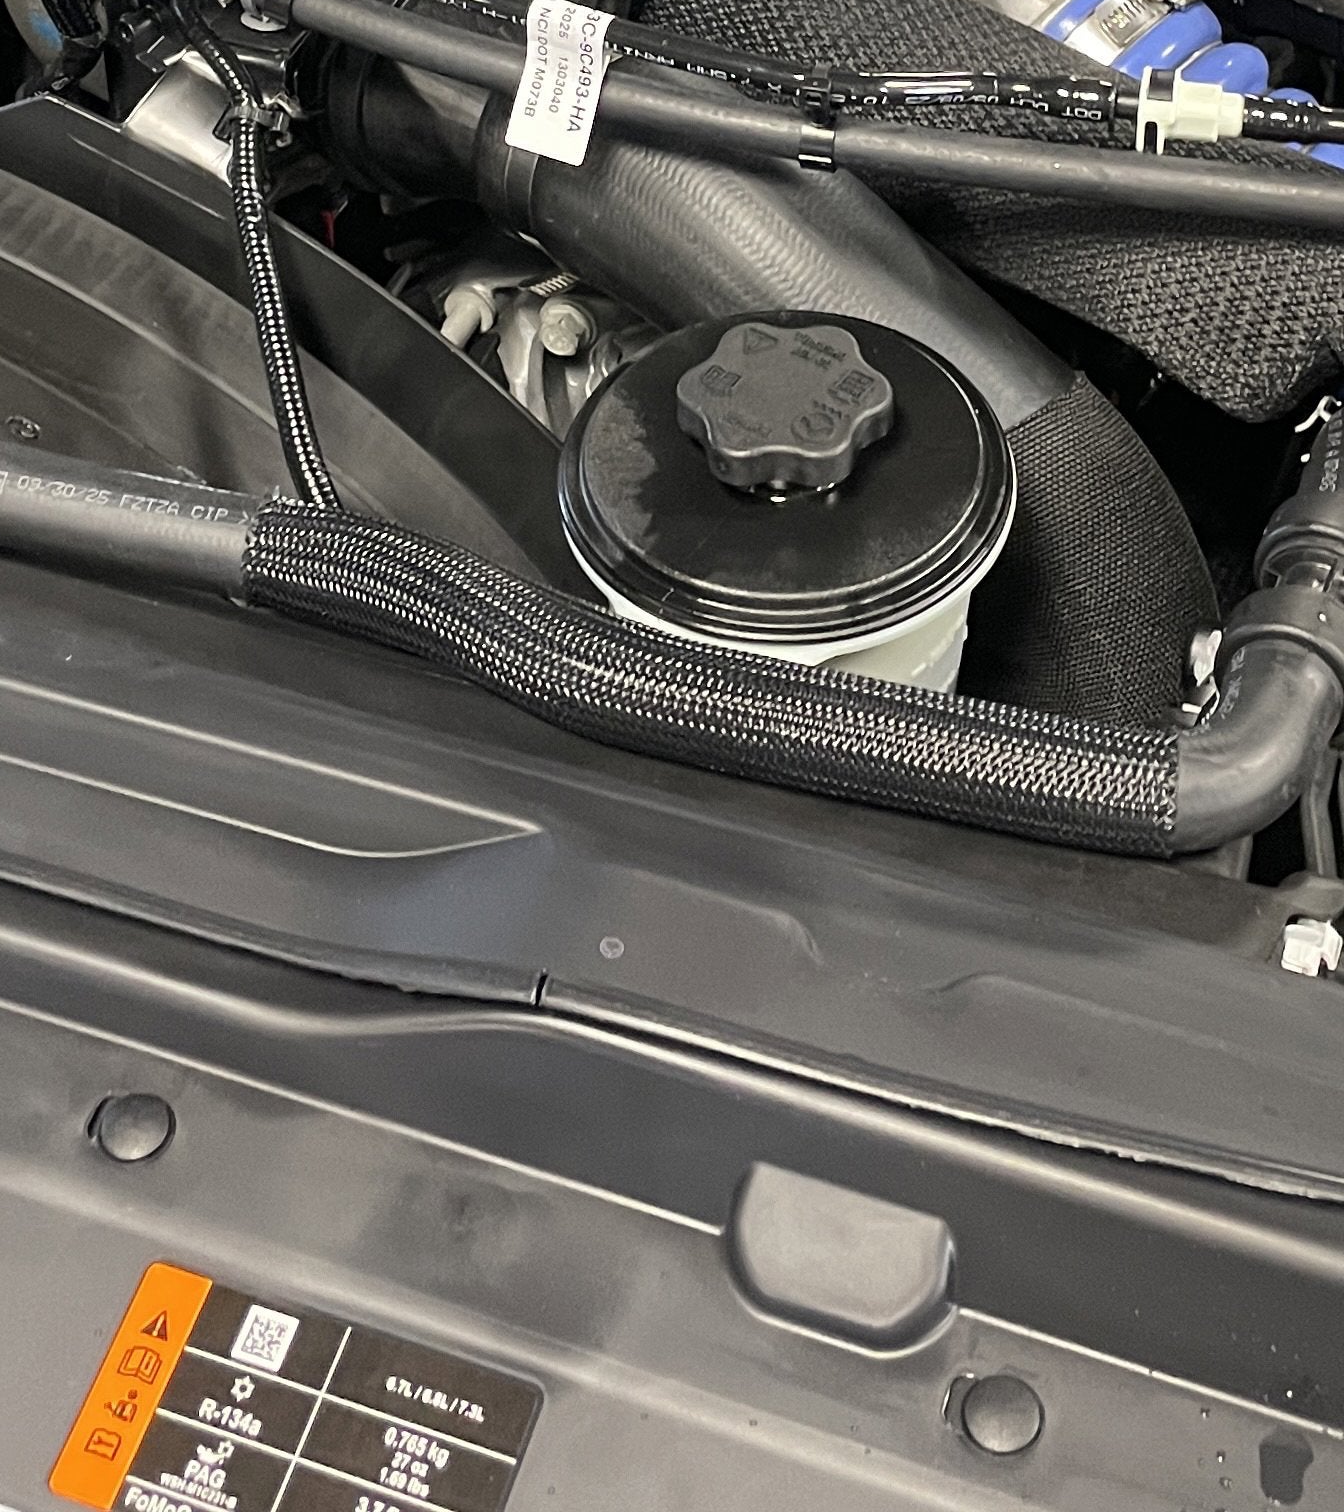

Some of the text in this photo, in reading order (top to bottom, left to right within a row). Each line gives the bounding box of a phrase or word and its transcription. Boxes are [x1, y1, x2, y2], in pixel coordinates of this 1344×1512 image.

[558, 7, 576, 39] 2025
[199, 1396, 263, 1437] R-134a
[383, 1426, 450, 1469] 0.765 kg
[391, 1452, 410, 1470] 27
[184, 1459, 227, 1489] PAG
[380, 1466, 430, 1498] 1.69 lbs
